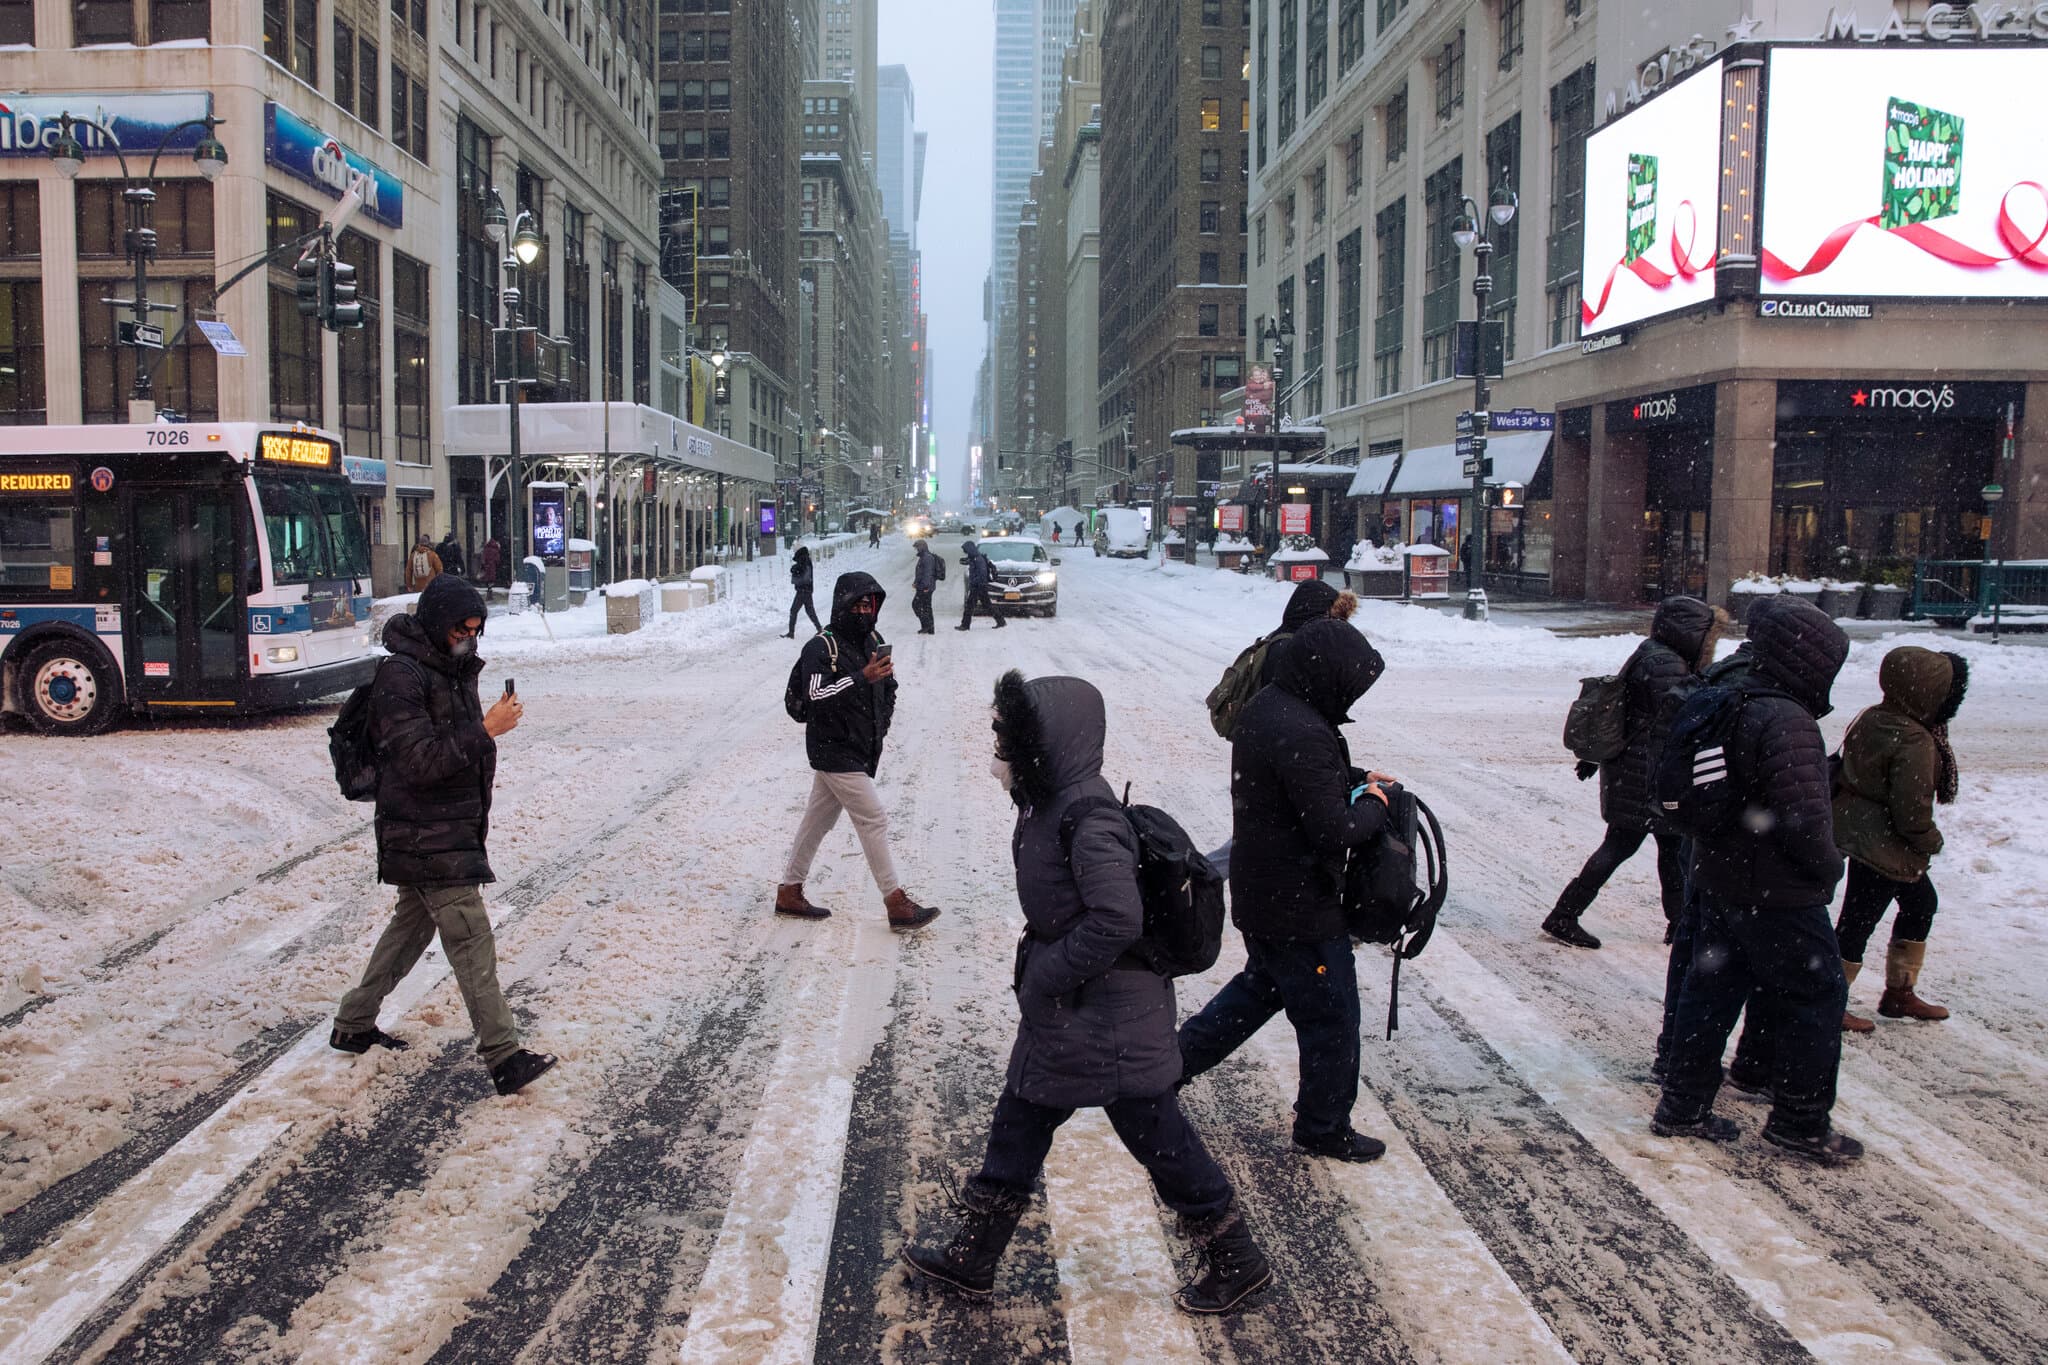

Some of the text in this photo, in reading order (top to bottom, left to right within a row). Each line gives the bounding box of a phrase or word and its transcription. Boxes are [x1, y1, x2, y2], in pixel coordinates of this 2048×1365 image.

[1908, 138, 1950, 164] HAPPY
[1893, 165, 1955, 190] HOLIDAYS
[1640, 394, 1677, 420] macy's
[1870, 384, 1955, 414] macy's
[1496, 415, 1550, 427] West 34th St
[146, 430, 190, 446] 7026
[291, 439, 330, 465] REQUIRED
[1, 474, 72, 491] REQUIRED
[0, 620, 20, 629] 7026
